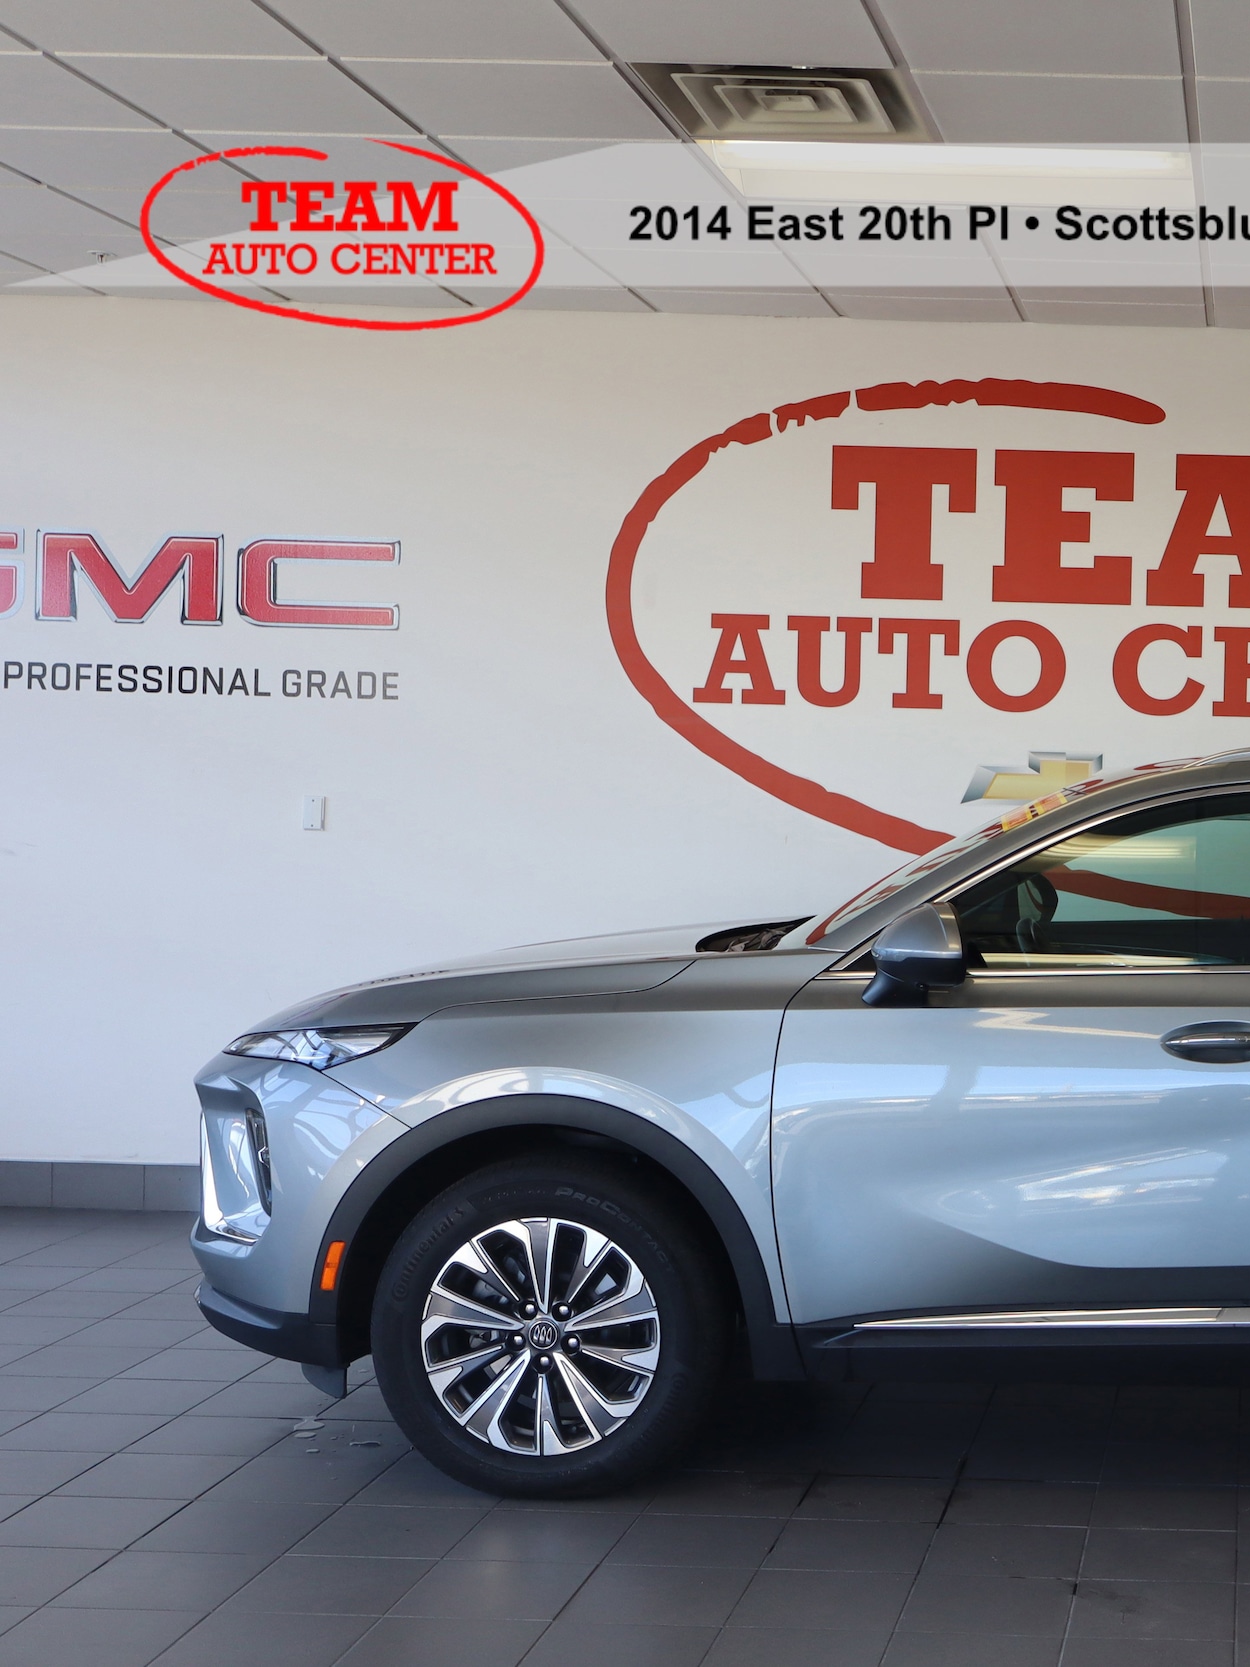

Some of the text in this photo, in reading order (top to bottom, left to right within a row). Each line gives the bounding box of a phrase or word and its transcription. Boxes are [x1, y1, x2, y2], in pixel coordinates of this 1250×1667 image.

[0, 528, 402, 631] MC
[3, 660, 400, 701] PROFESSIONAL GRADE
[692, 612, 1067, 714] AUTO
